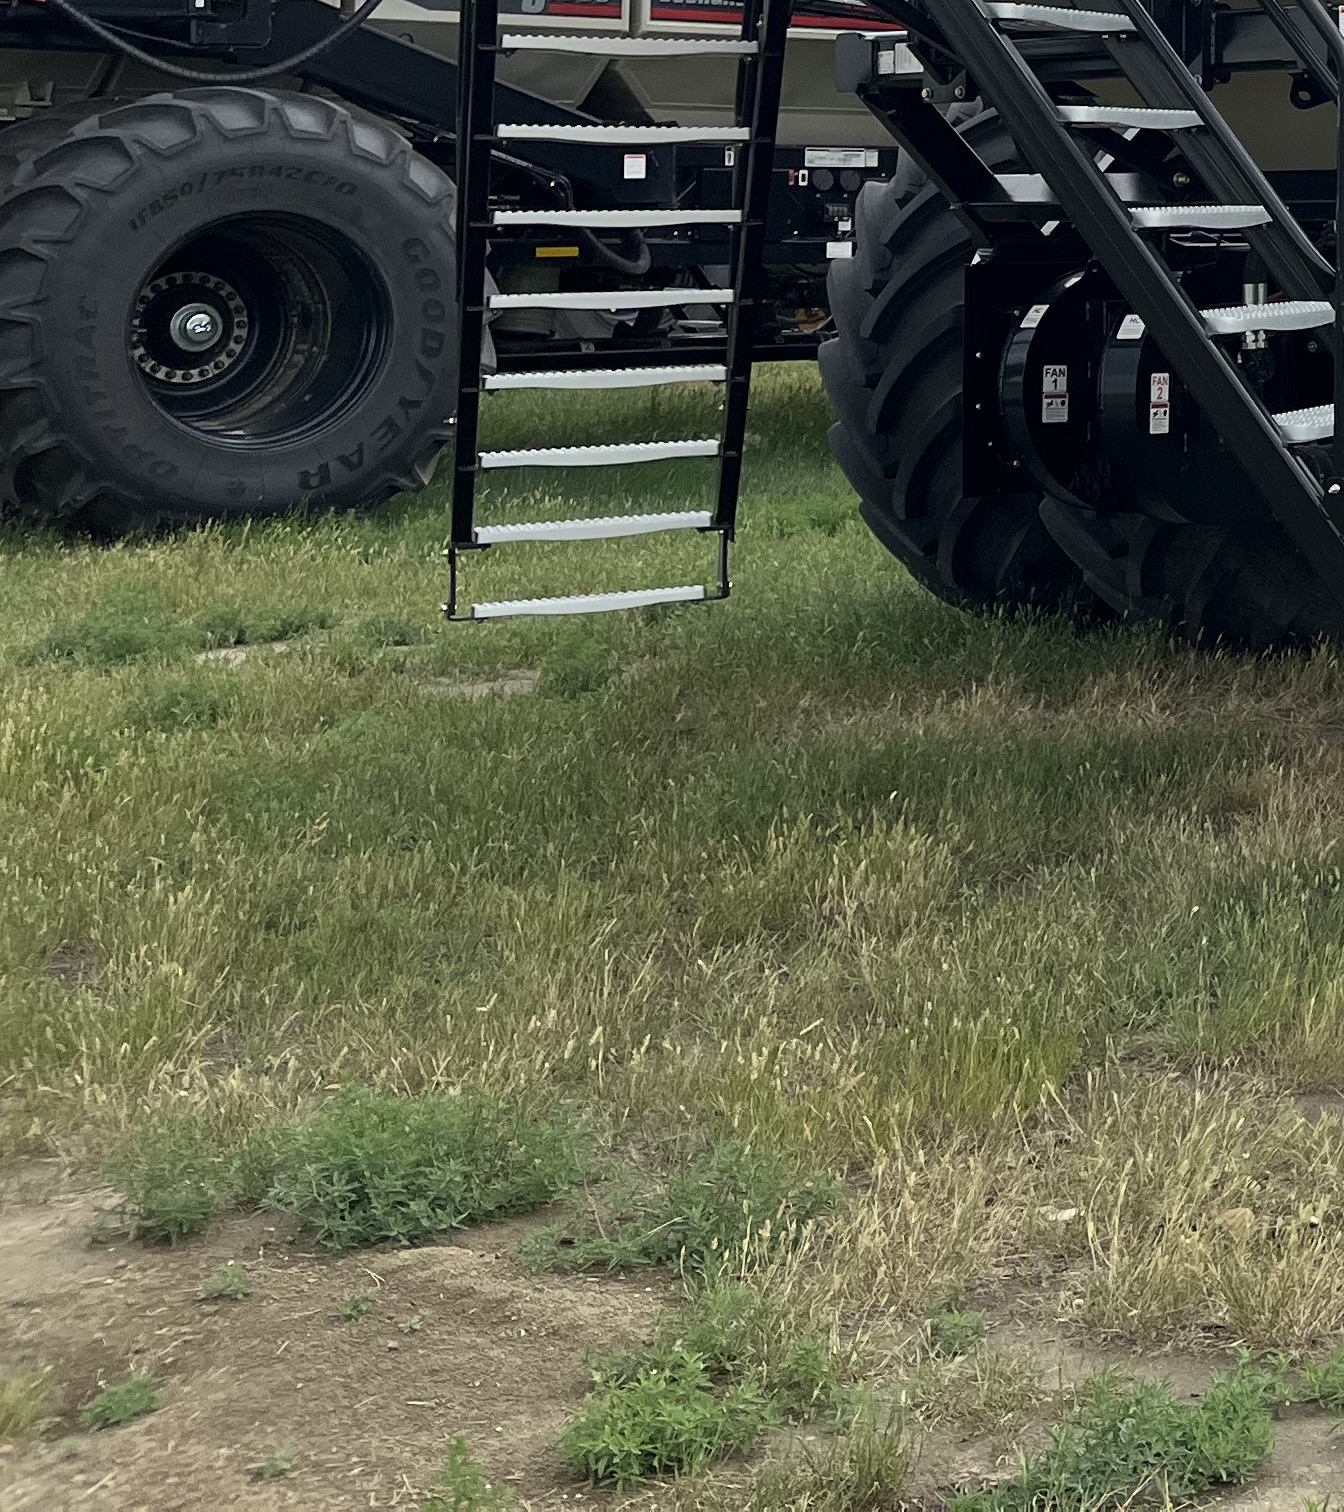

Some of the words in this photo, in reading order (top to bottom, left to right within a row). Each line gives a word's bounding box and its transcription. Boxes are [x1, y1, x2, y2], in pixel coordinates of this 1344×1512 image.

[297, 237, 446, 490] GOODYEAR
[1045, 368, 1066, 378] FAN
[1051, 378, 1058, 391] 1
[1152, 376, 1168, 386] FAN
[1156, 387, 1163, 400] 2
